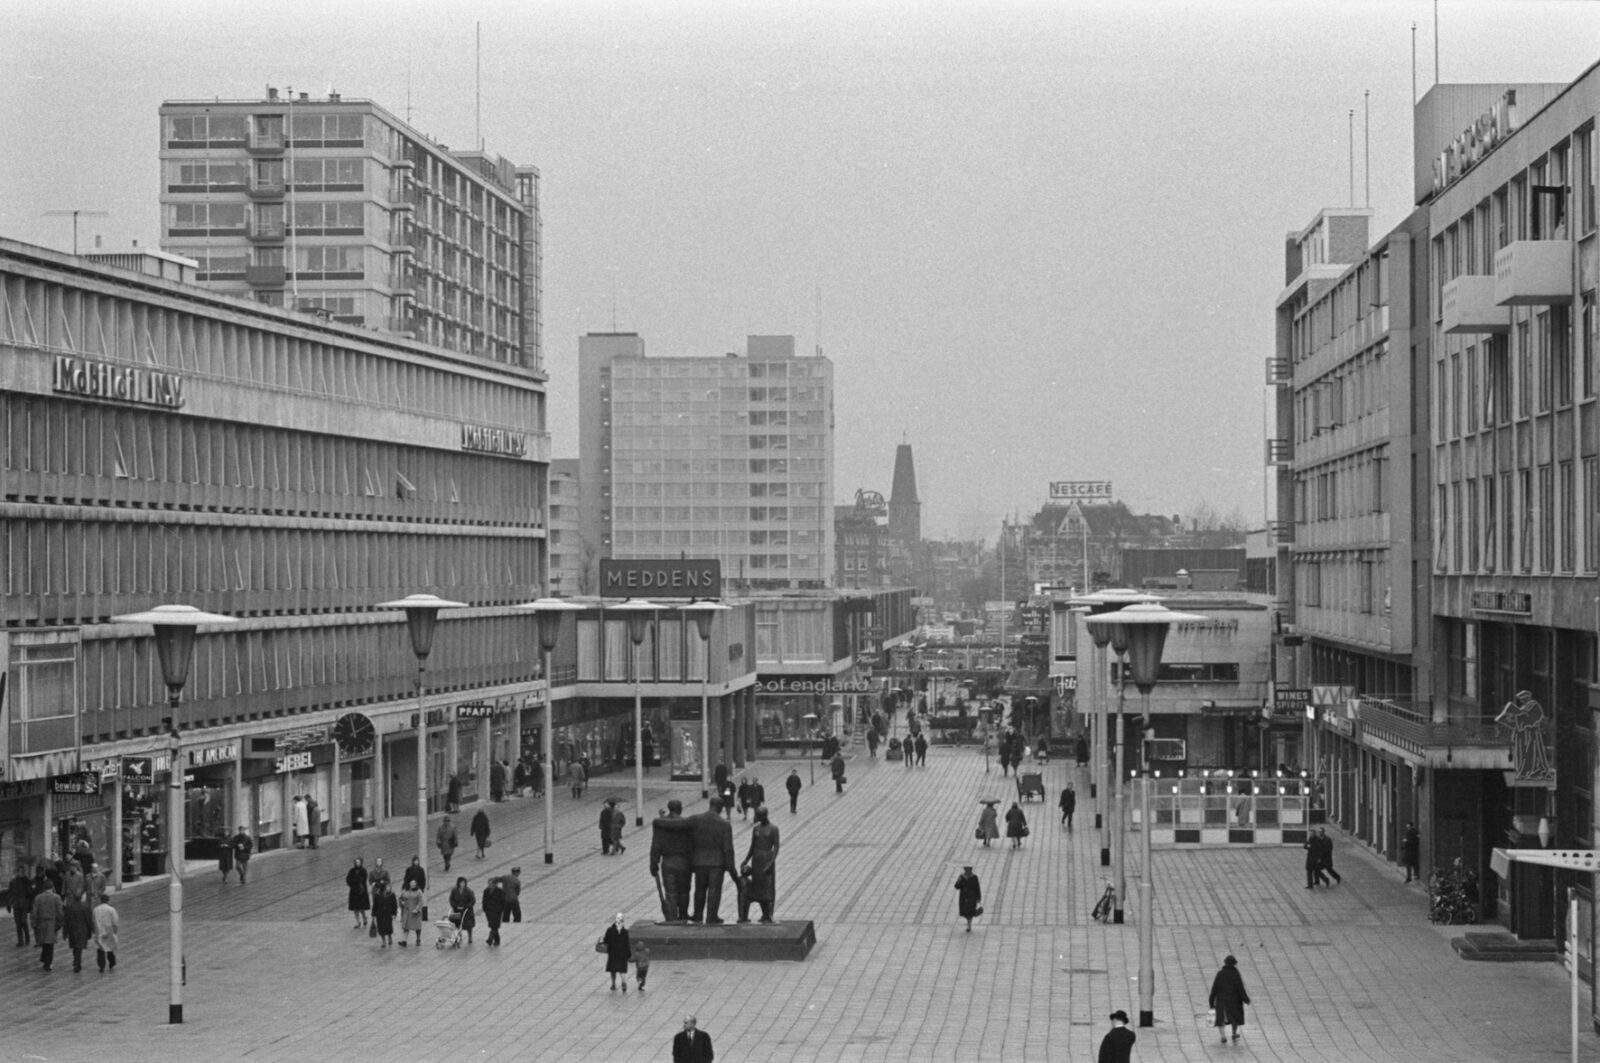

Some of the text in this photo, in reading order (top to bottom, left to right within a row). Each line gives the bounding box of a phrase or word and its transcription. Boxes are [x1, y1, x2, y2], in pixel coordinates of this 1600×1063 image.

[606, 569, 713, 588] MEDDENS
[766, 678, 787, 692] of
[790, 677, 869, 696] england
[1275, 691, 1309, 700] WINES
[458, 707, 493, 717] PFAFF
[275, 751, 315, 774] SIEBEL
